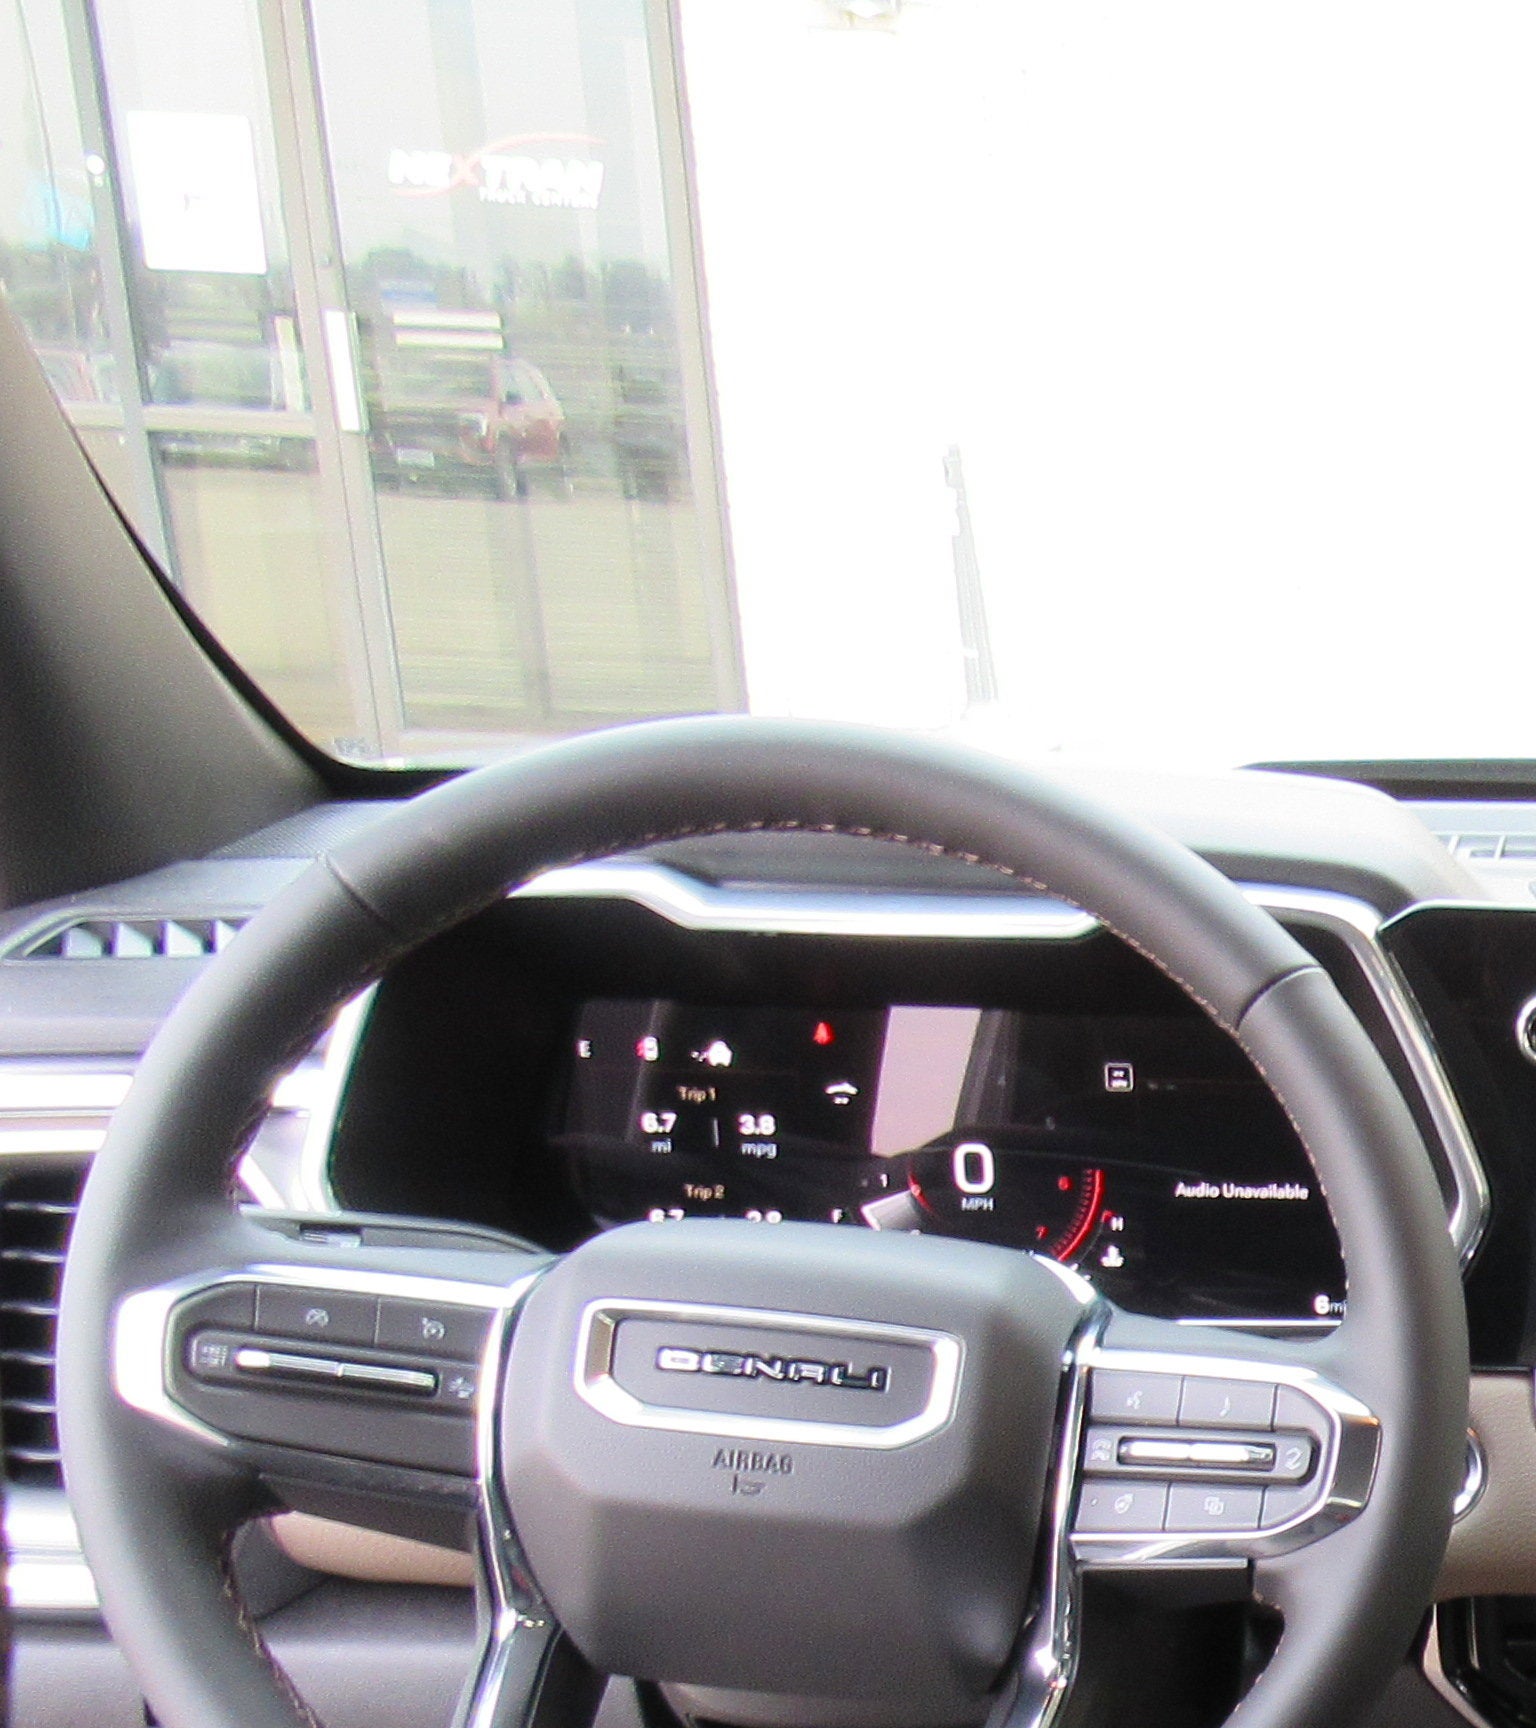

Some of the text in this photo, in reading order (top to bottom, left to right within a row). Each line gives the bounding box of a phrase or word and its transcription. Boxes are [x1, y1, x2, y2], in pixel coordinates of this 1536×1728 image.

[678, 1087, 708, 1103] Trip
[652, 1139, 672, 1154] mi
[741, 1142, 778, 1159] mpg
[953, 1141, 996, 1194] 0
[684, 1183, 713, 1200] Trip
[1175, 1181, 1310, 1201] Audio Unavailable
[960, 1197, 995, 1212] MPH
[655, 1345, 891, 1393] DENALI
[711, 1448, 795, 1476] AIRBAG
